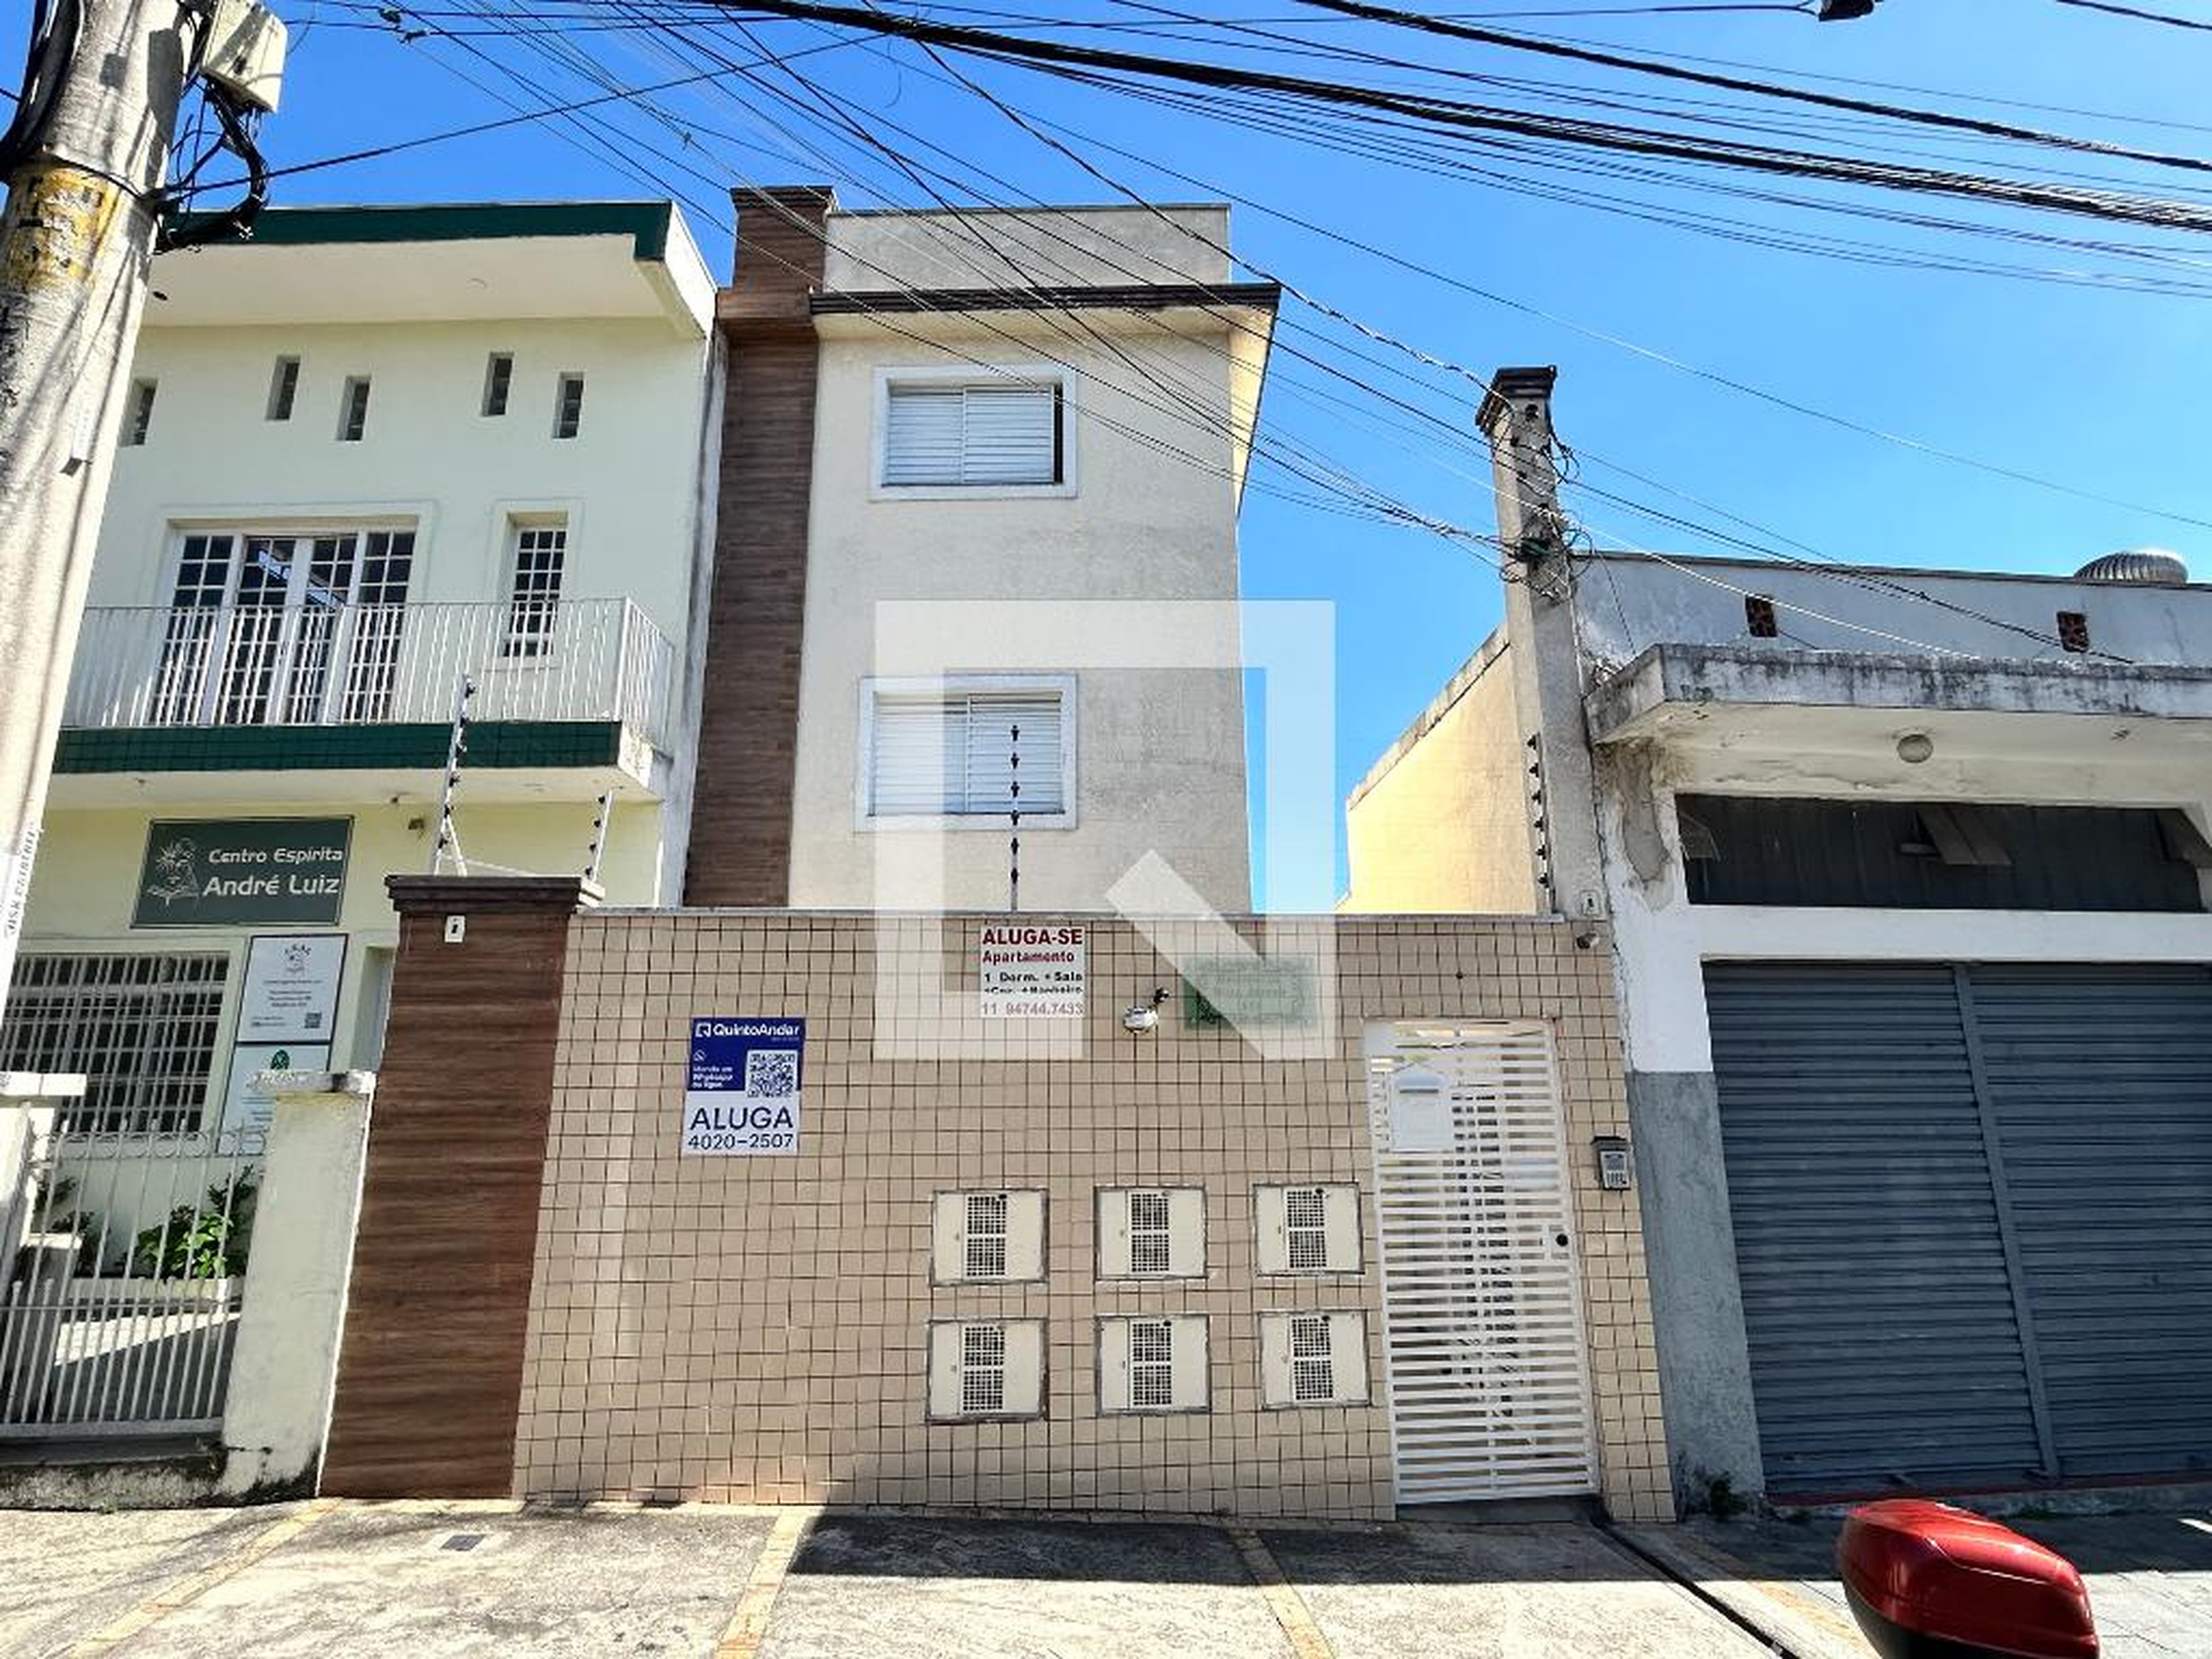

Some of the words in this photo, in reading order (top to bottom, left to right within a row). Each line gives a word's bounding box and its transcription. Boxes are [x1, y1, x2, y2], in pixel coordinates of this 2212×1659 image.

[208, 848, 267, 863] Centro
[203, 874, 280, 896] André
[289, 874, 340, 894] Luiz
[983, 929, 1083, 945] ALUGA-SE
[983, 950, 1075, 965] Apartamento
[983, 1002, 997, 1014] 11
[713, 1023, 800, 1036] QuintoAndar
[690, 1107, 793, 1130] ALUGA
[688, 1134, 794, 1150] 4020-2507
